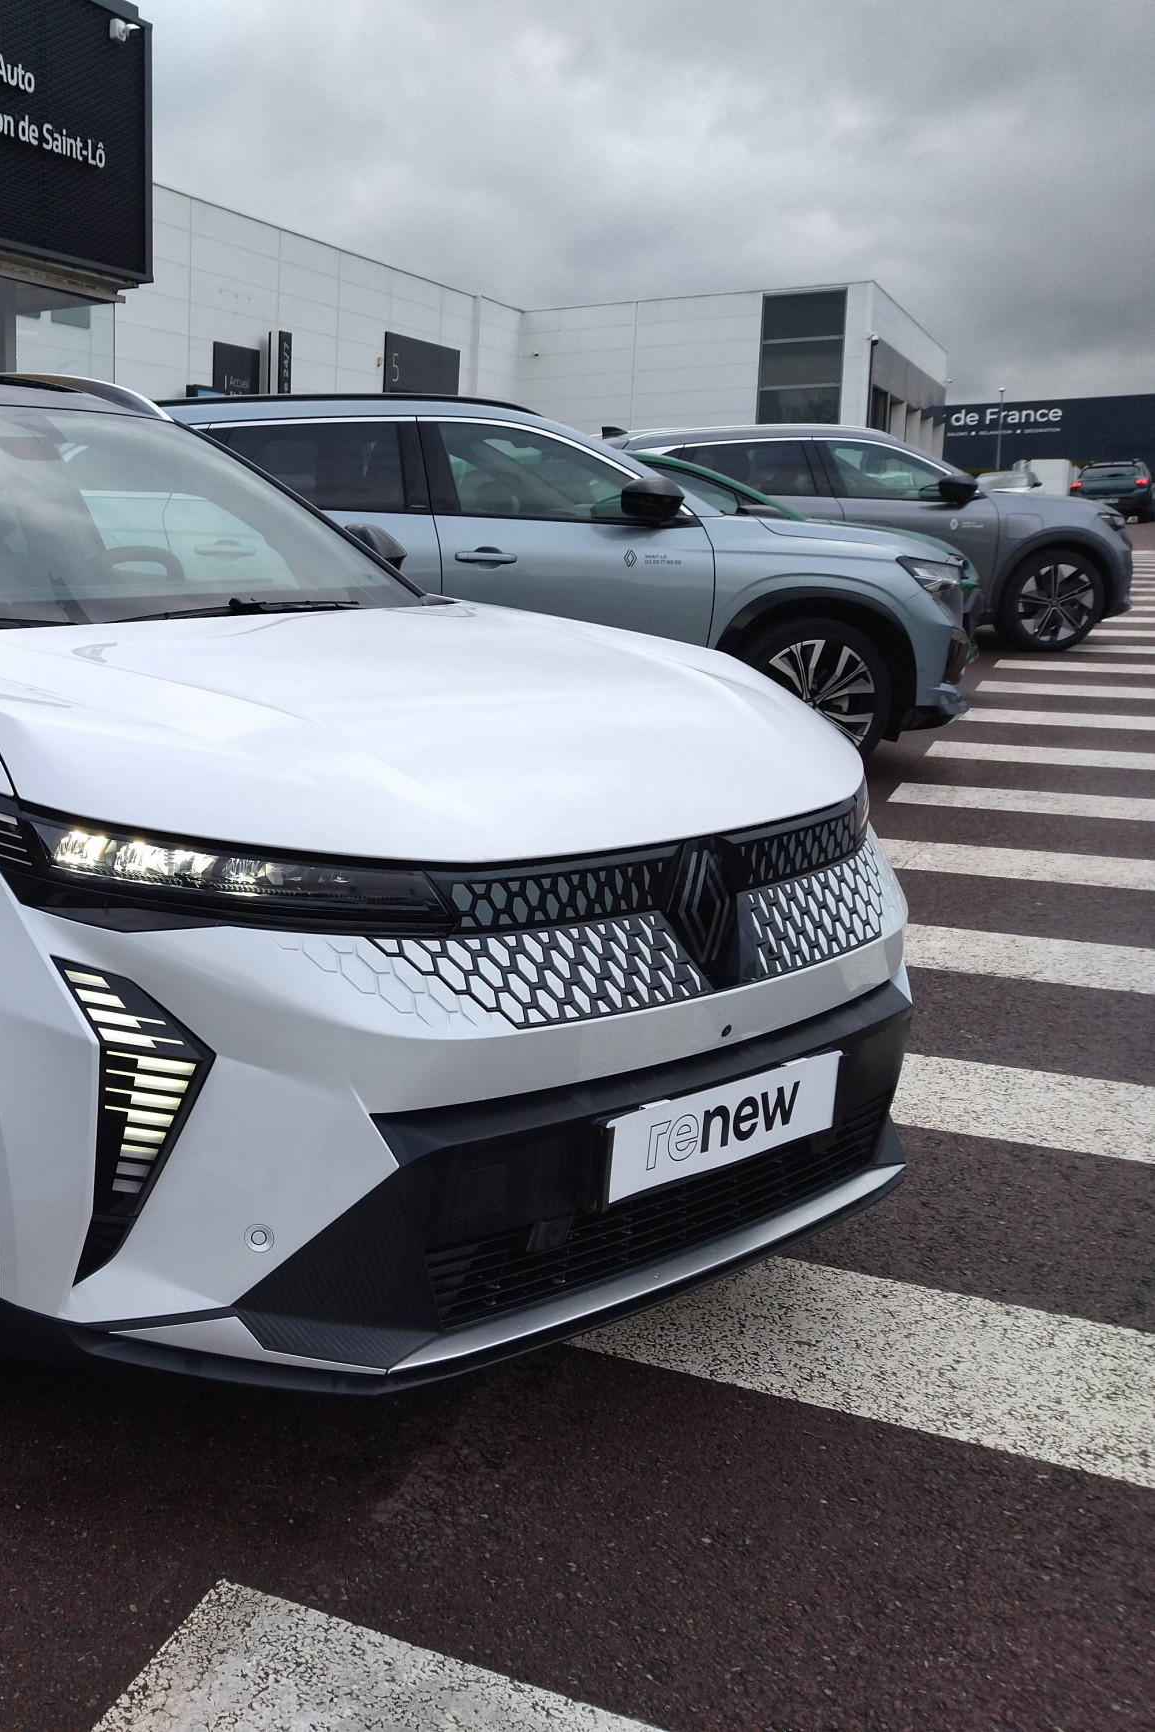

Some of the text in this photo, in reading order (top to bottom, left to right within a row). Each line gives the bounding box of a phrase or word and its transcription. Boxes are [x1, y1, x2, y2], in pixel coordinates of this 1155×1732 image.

[18, 115, 39, 146] de
[42, 123, 106, 168] Saint-Lô
[391, 353, 400, 382] 5
[950, 408, 1063, 426] de France
[646, 1080, 800, 1171] renew
